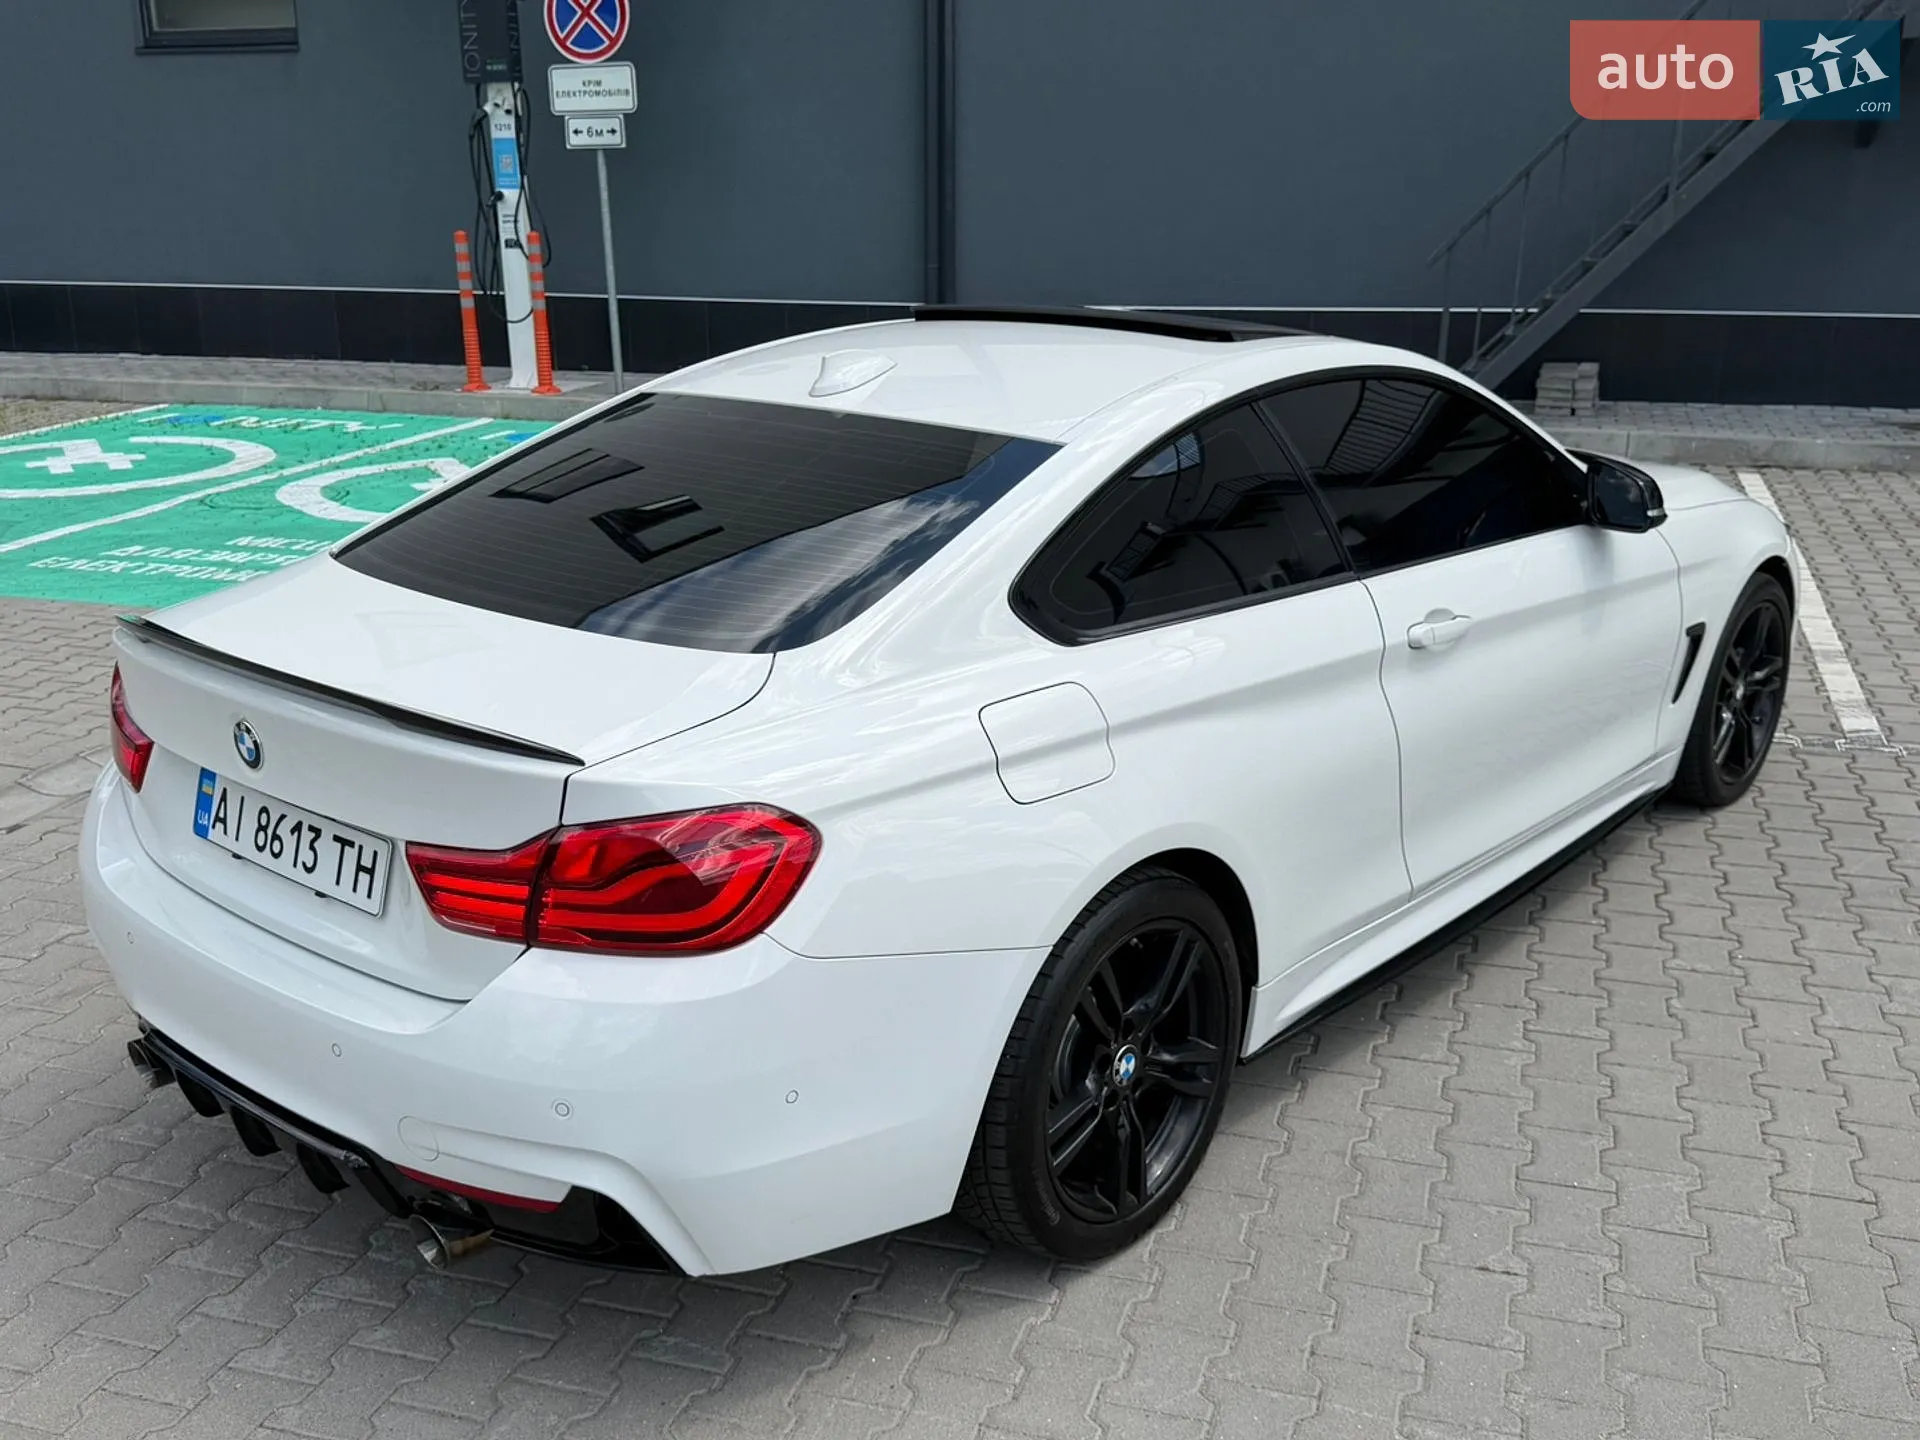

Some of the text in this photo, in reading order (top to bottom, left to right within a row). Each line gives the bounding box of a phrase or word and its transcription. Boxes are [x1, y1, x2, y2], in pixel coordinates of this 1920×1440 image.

[582, 79, 602, 88] КРІМ
[197, 809, 209, 827] UA
[212, 787, 378, 900] AI 8613 TH
